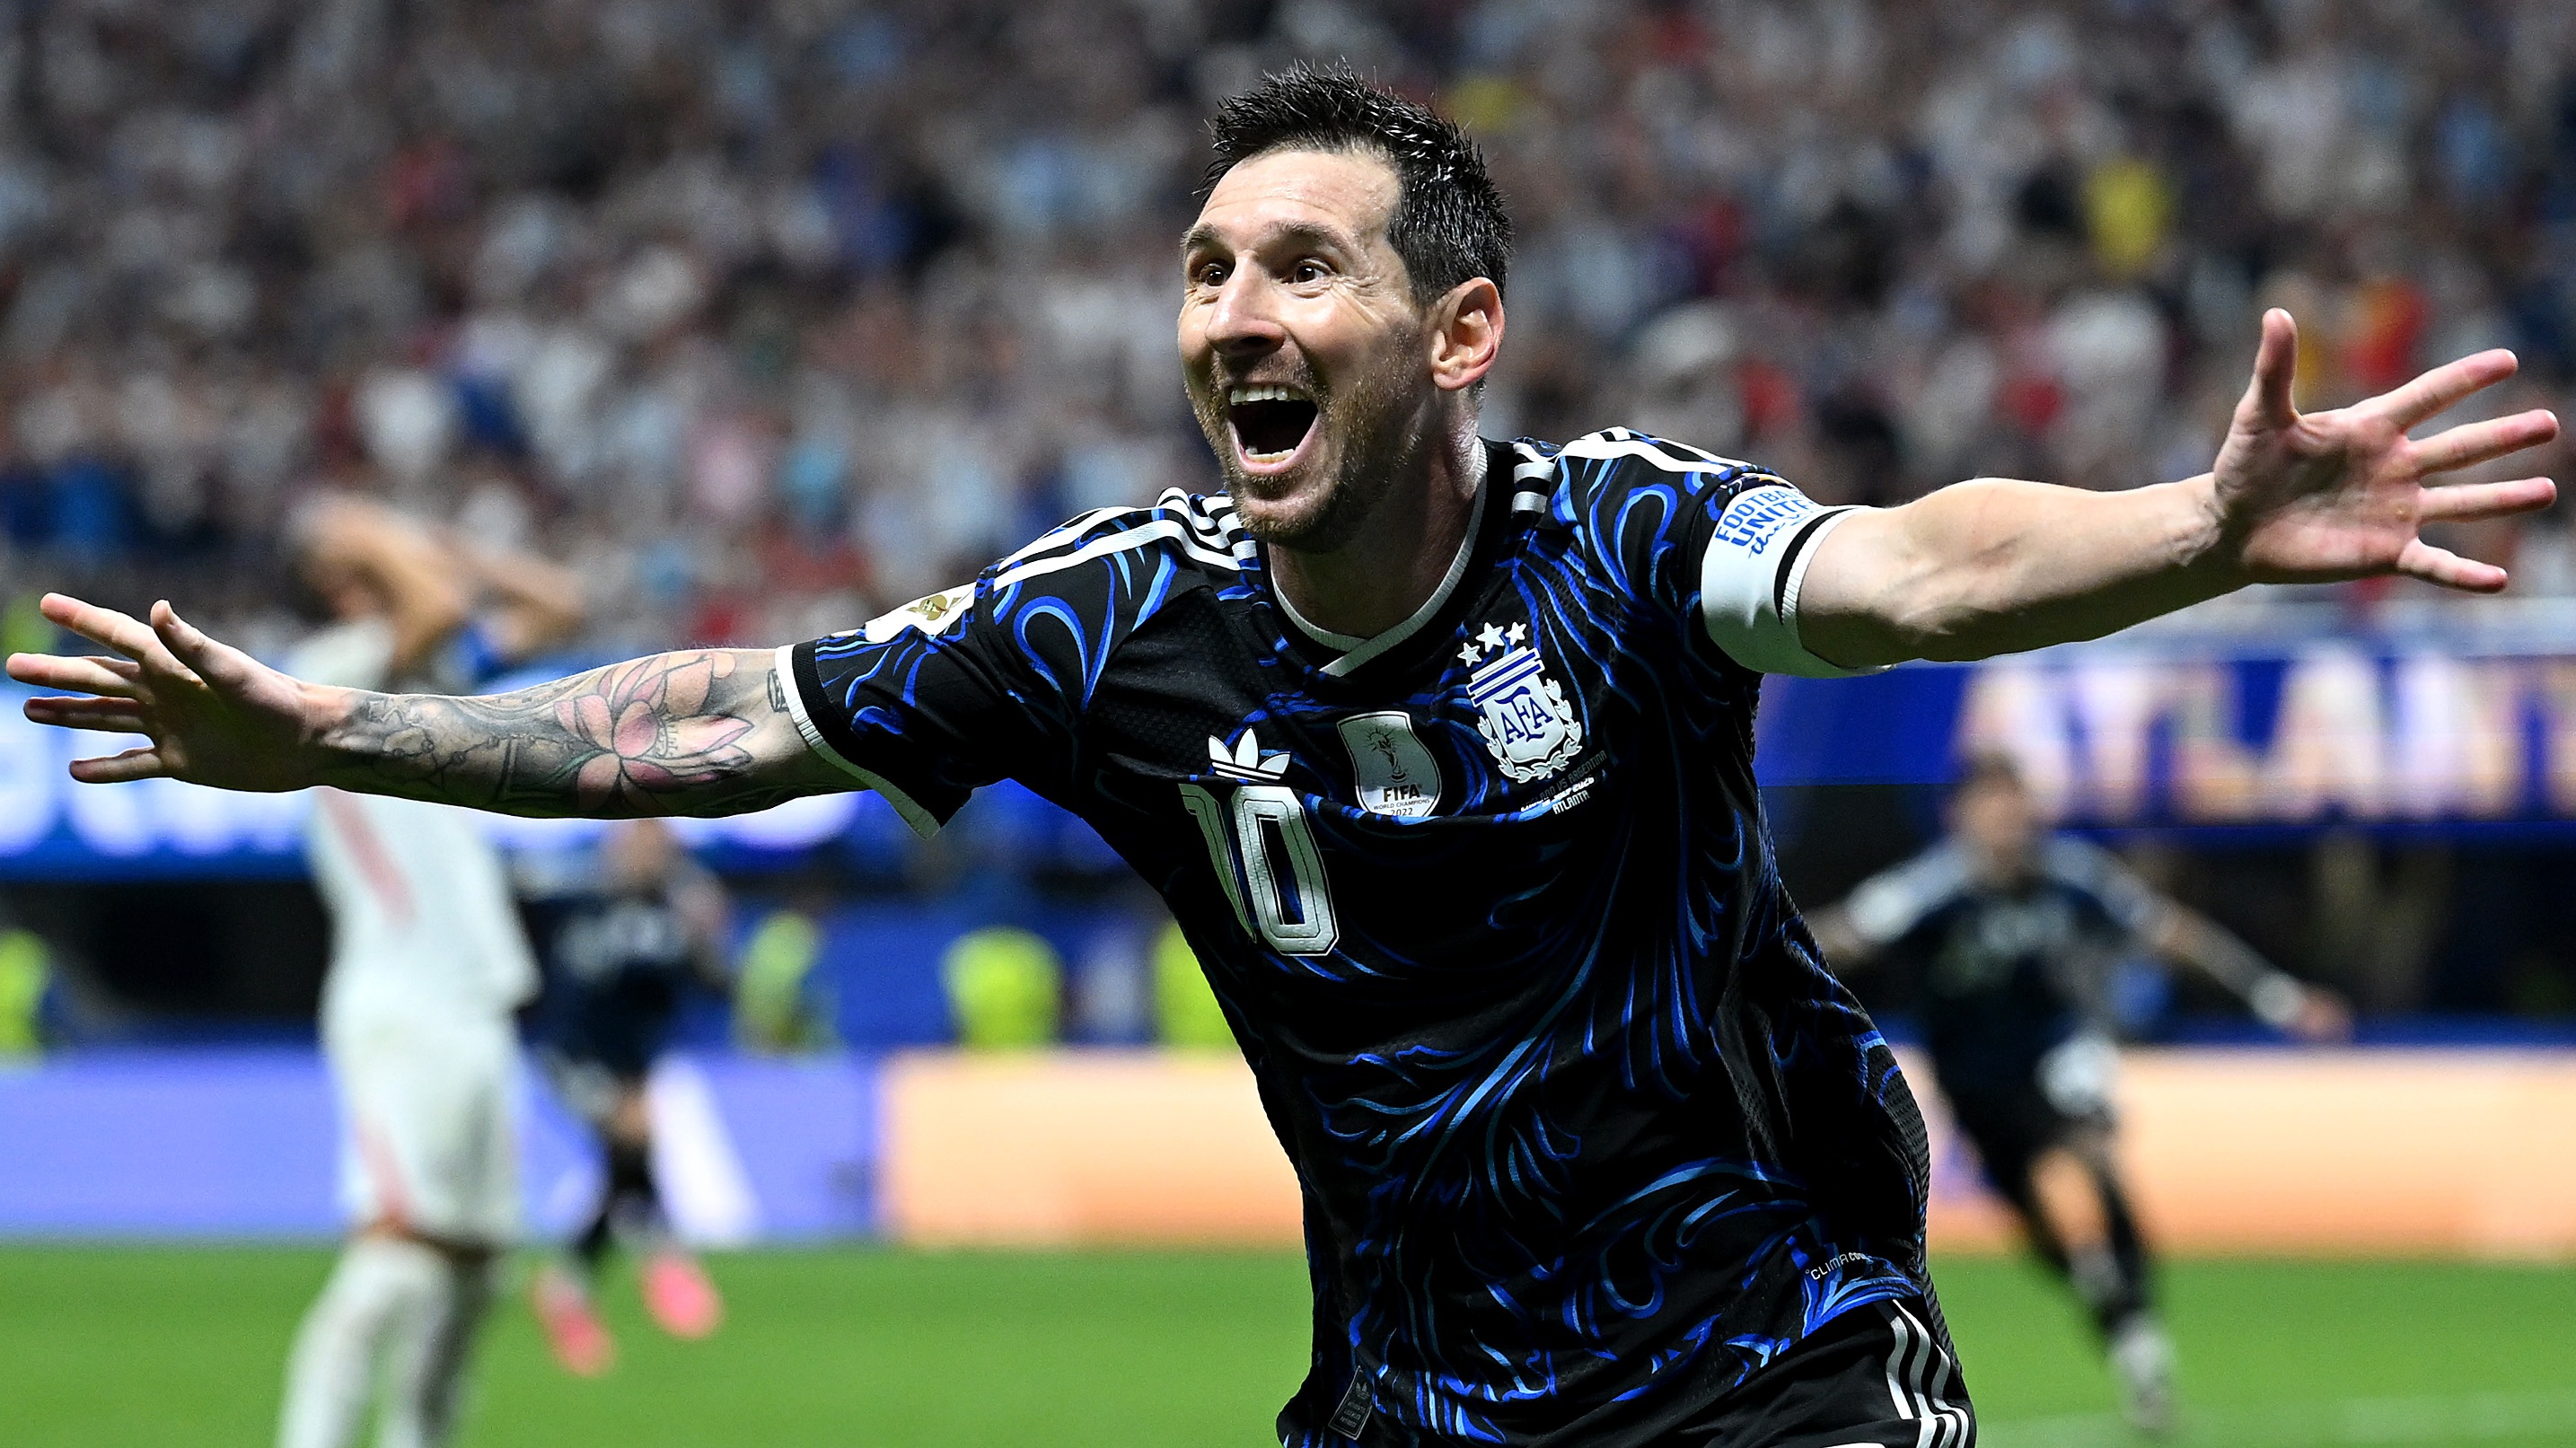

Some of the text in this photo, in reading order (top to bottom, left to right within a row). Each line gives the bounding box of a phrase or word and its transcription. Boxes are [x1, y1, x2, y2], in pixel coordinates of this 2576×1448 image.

[1715, 487, 1805, 542] FOOTBA
[1731, 499, 1815, 547] UNITE
[1494, 686, 1553, 745] AFA
[1373, 798, 1430, 811] WORLD CHAMPIONS
[1384, 784, 1420, 803] FIFA
[1391, 807, 1414, 817] 2022
[1552, 789, 1591, 815] ATLANTA
[1178, 783, 1340, 956] 10
